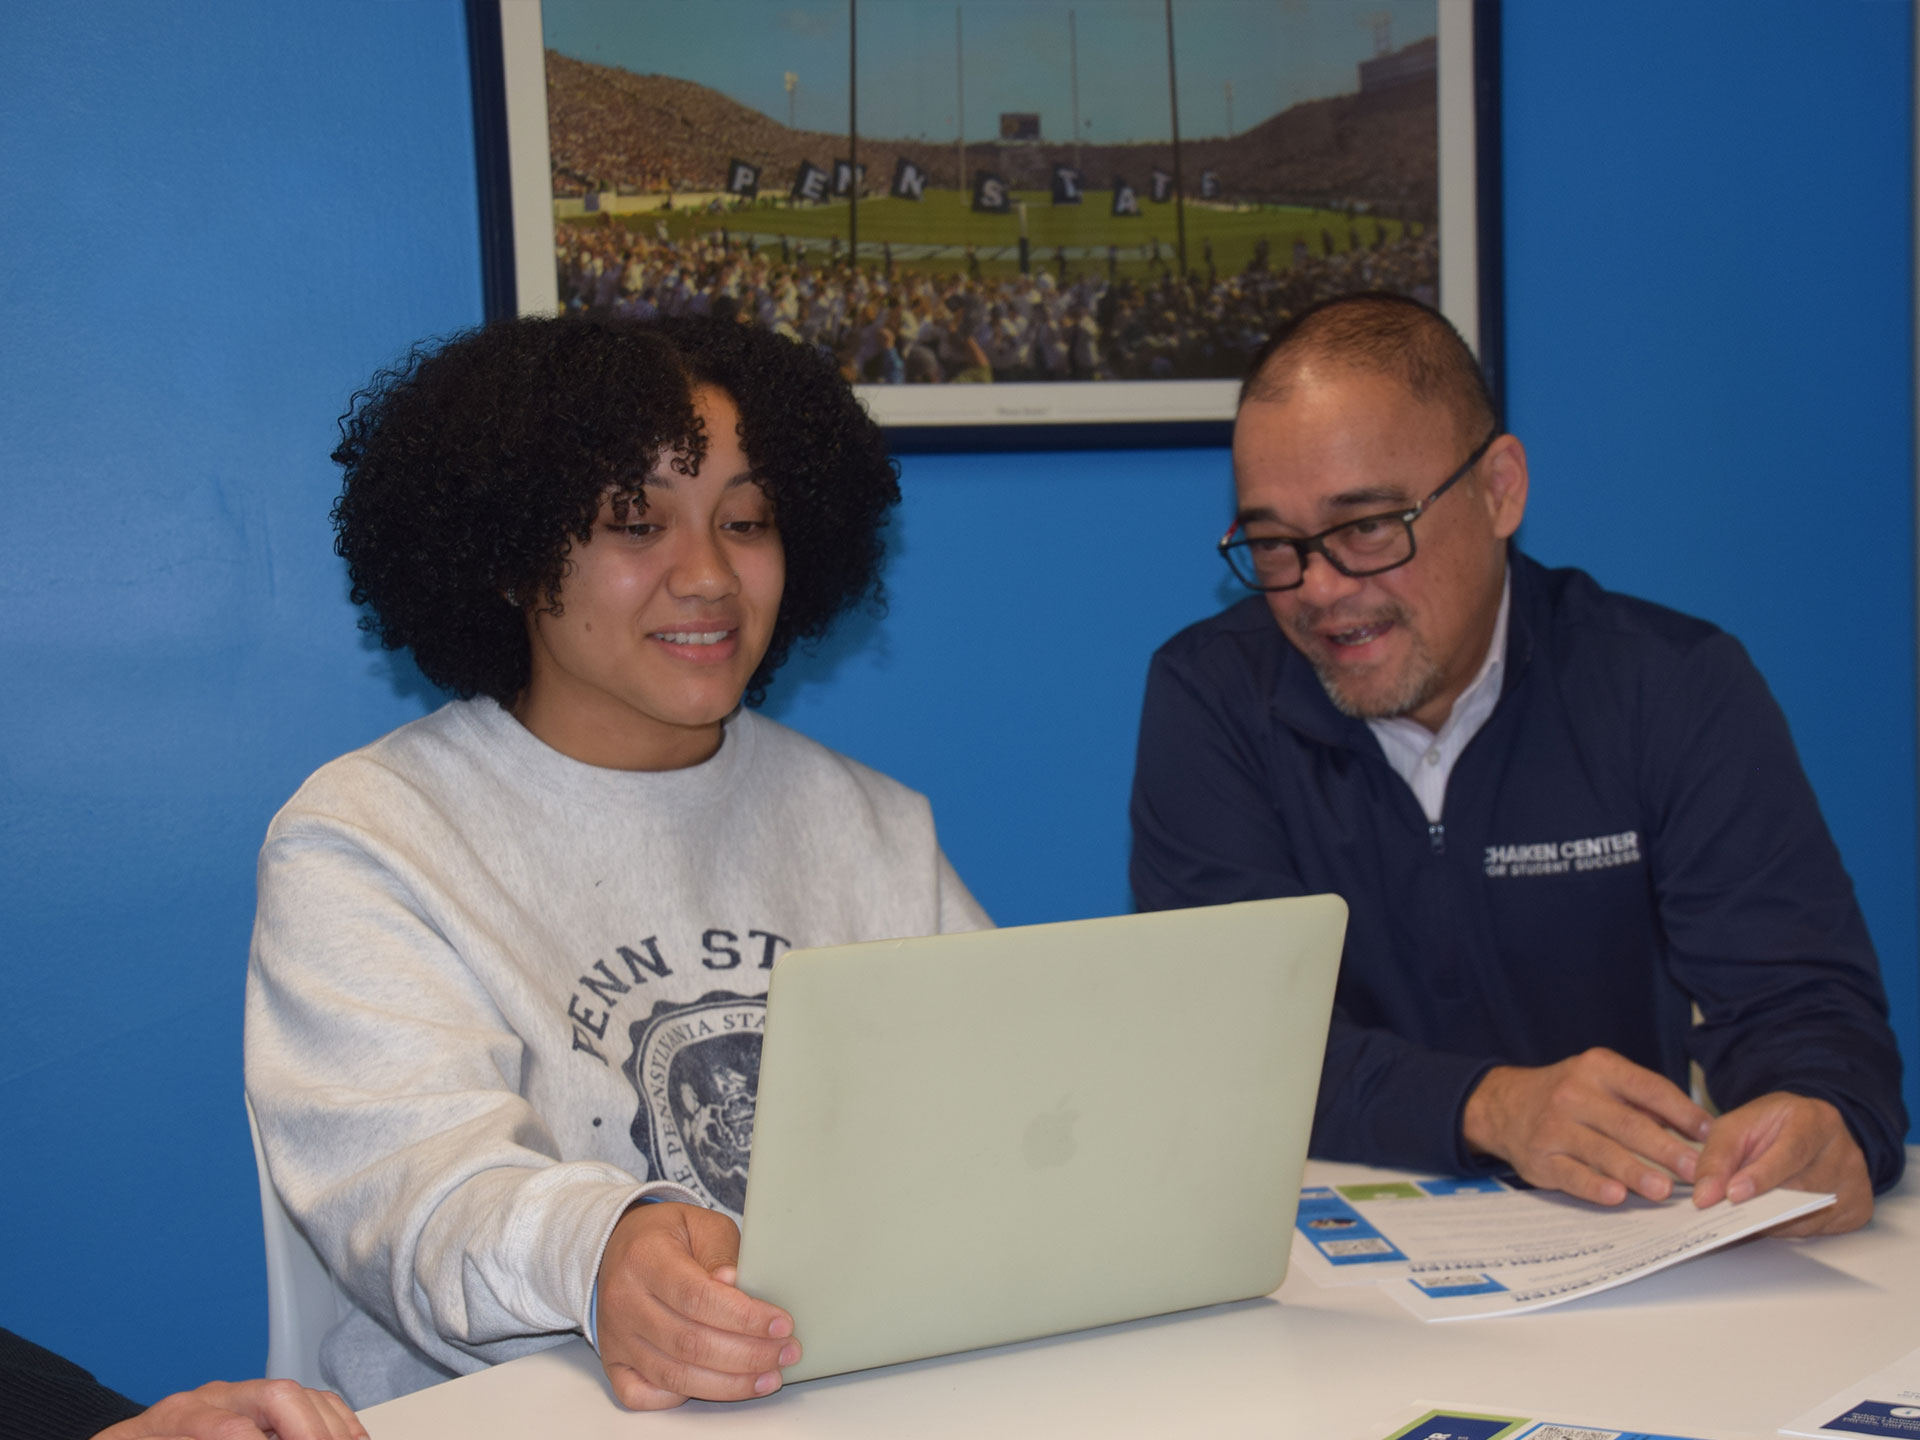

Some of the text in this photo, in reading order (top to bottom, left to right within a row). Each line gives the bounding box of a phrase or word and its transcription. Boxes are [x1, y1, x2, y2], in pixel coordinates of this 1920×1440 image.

[1560, 830, 1639, 859] CENTER
[1511, 860, 1570, 877] STUDENT
[1575, 850, 1641, 872] SUCCESS
[567, 935, 674, 1067] PENN
